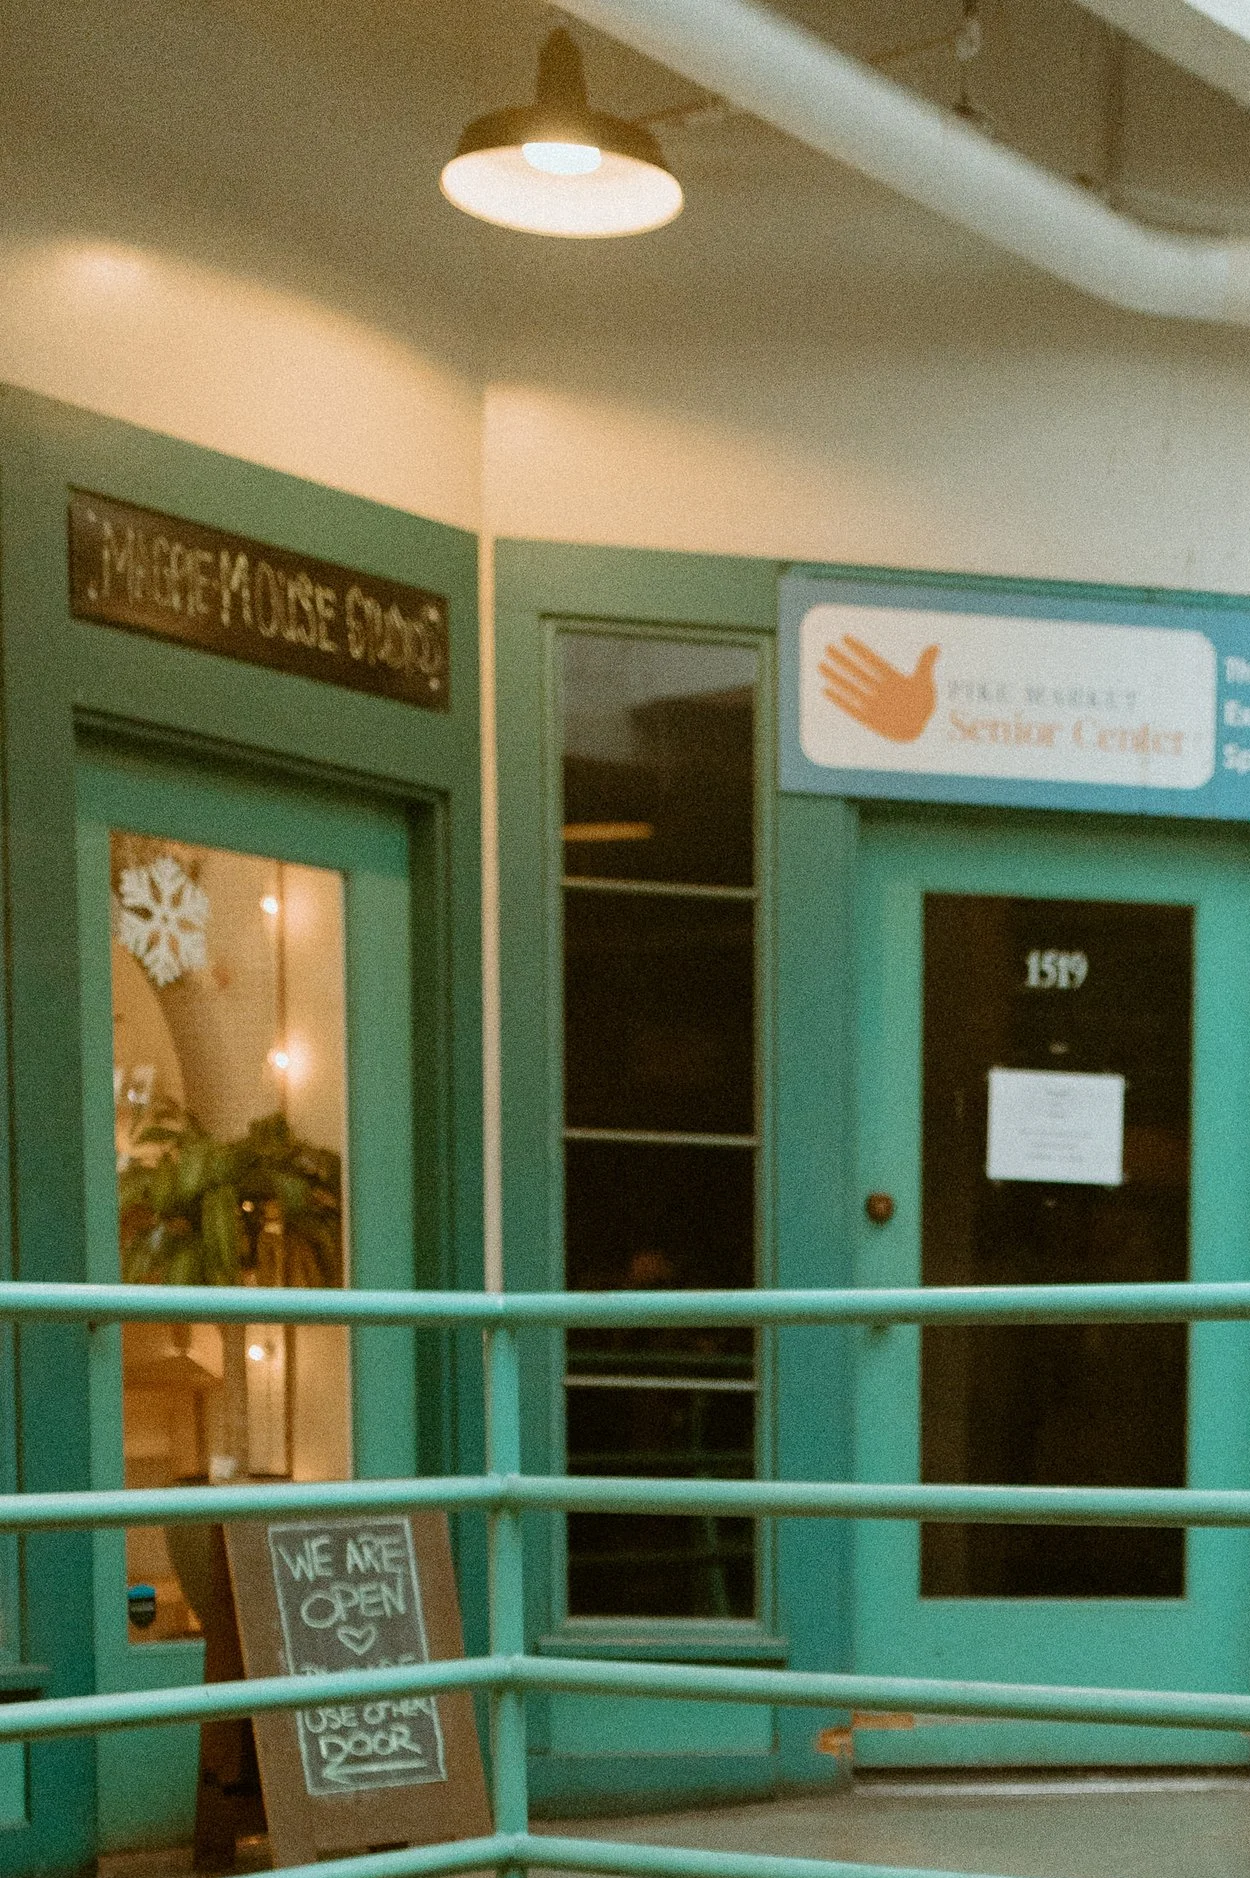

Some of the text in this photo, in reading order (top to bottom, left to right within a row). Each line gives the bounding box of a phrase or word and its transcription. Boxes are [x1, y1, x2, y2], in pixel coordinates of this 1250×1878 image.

[949, 711, 1184, 758] Senior Center
[1026, 948, 1089, 990] 1519
[277, 1533, 406, 1582] WE ARE
[301, 1568, 407, 1630] OPEN
[304, 1706, 358, 1733] USE
[318, 1722, 422, 1763] DOOR
